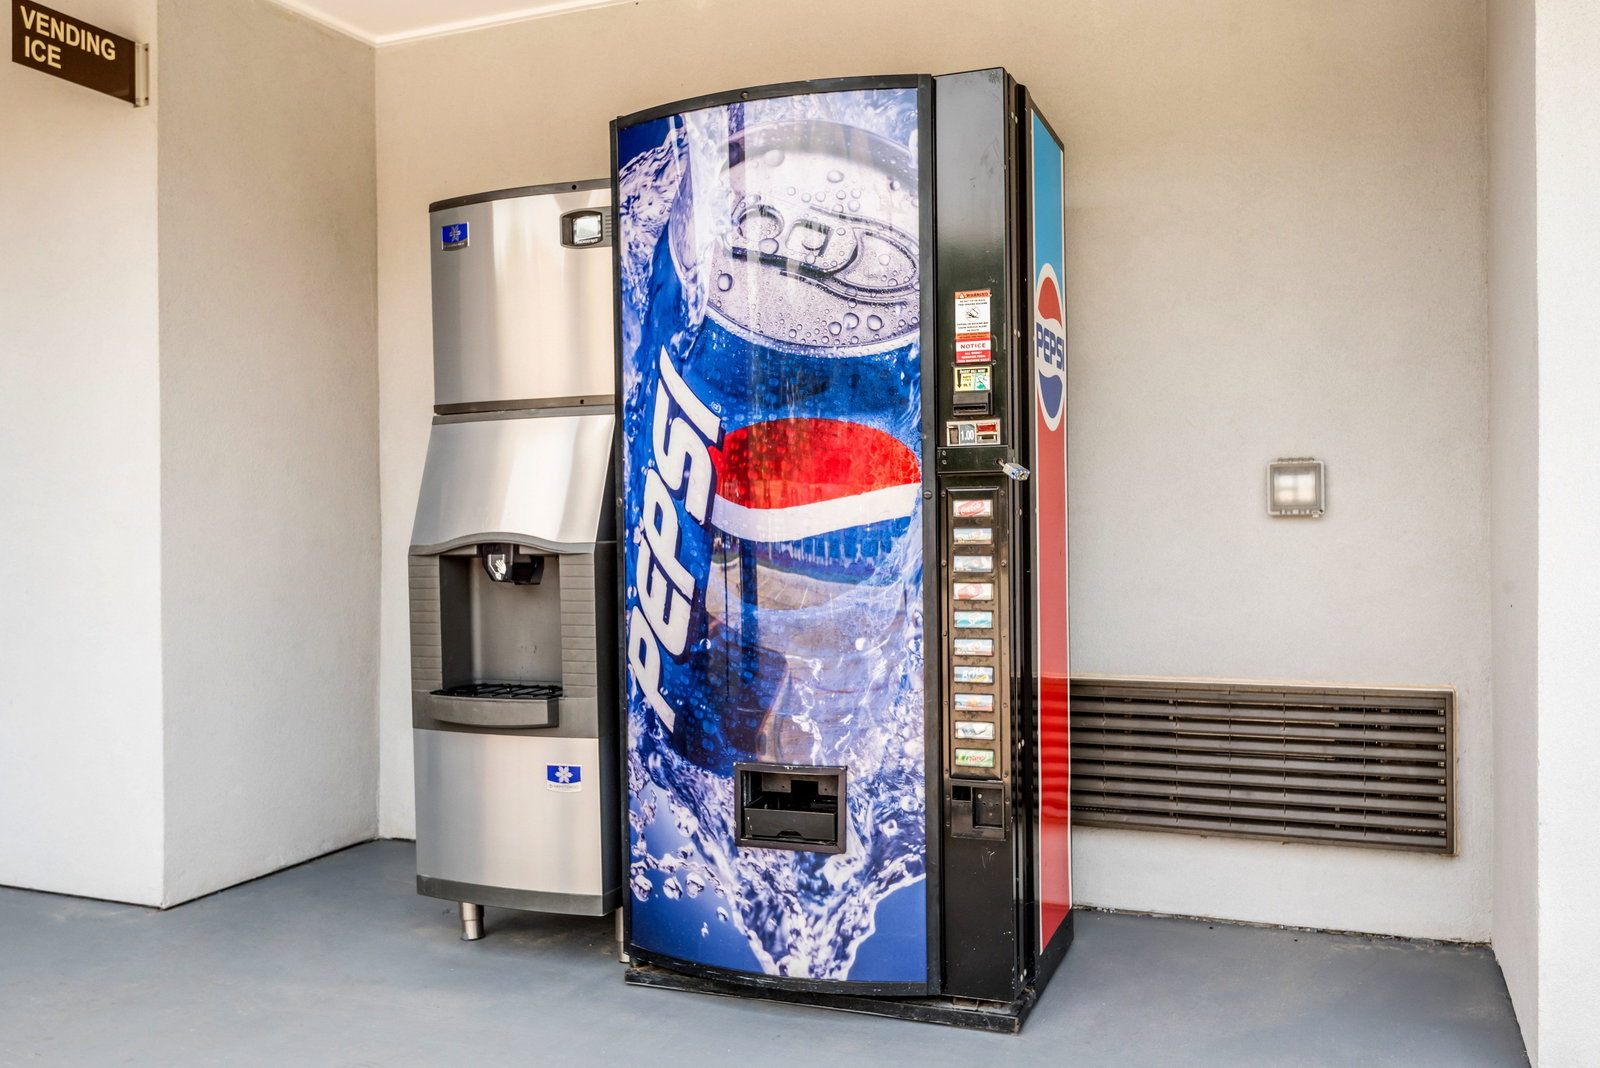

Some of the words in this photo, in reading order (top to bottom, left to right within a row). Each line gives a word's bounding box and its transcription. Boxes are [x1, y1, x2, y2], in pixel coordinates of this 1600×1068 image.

[20, 5, 116, 60] VENDING
[25, 35, 61, 69] ICE
[1036, 321, 1065, 372] PEPSI
[960, 430, 974, 441] 1.00
[627, 344, 722, 733] PEPSI
